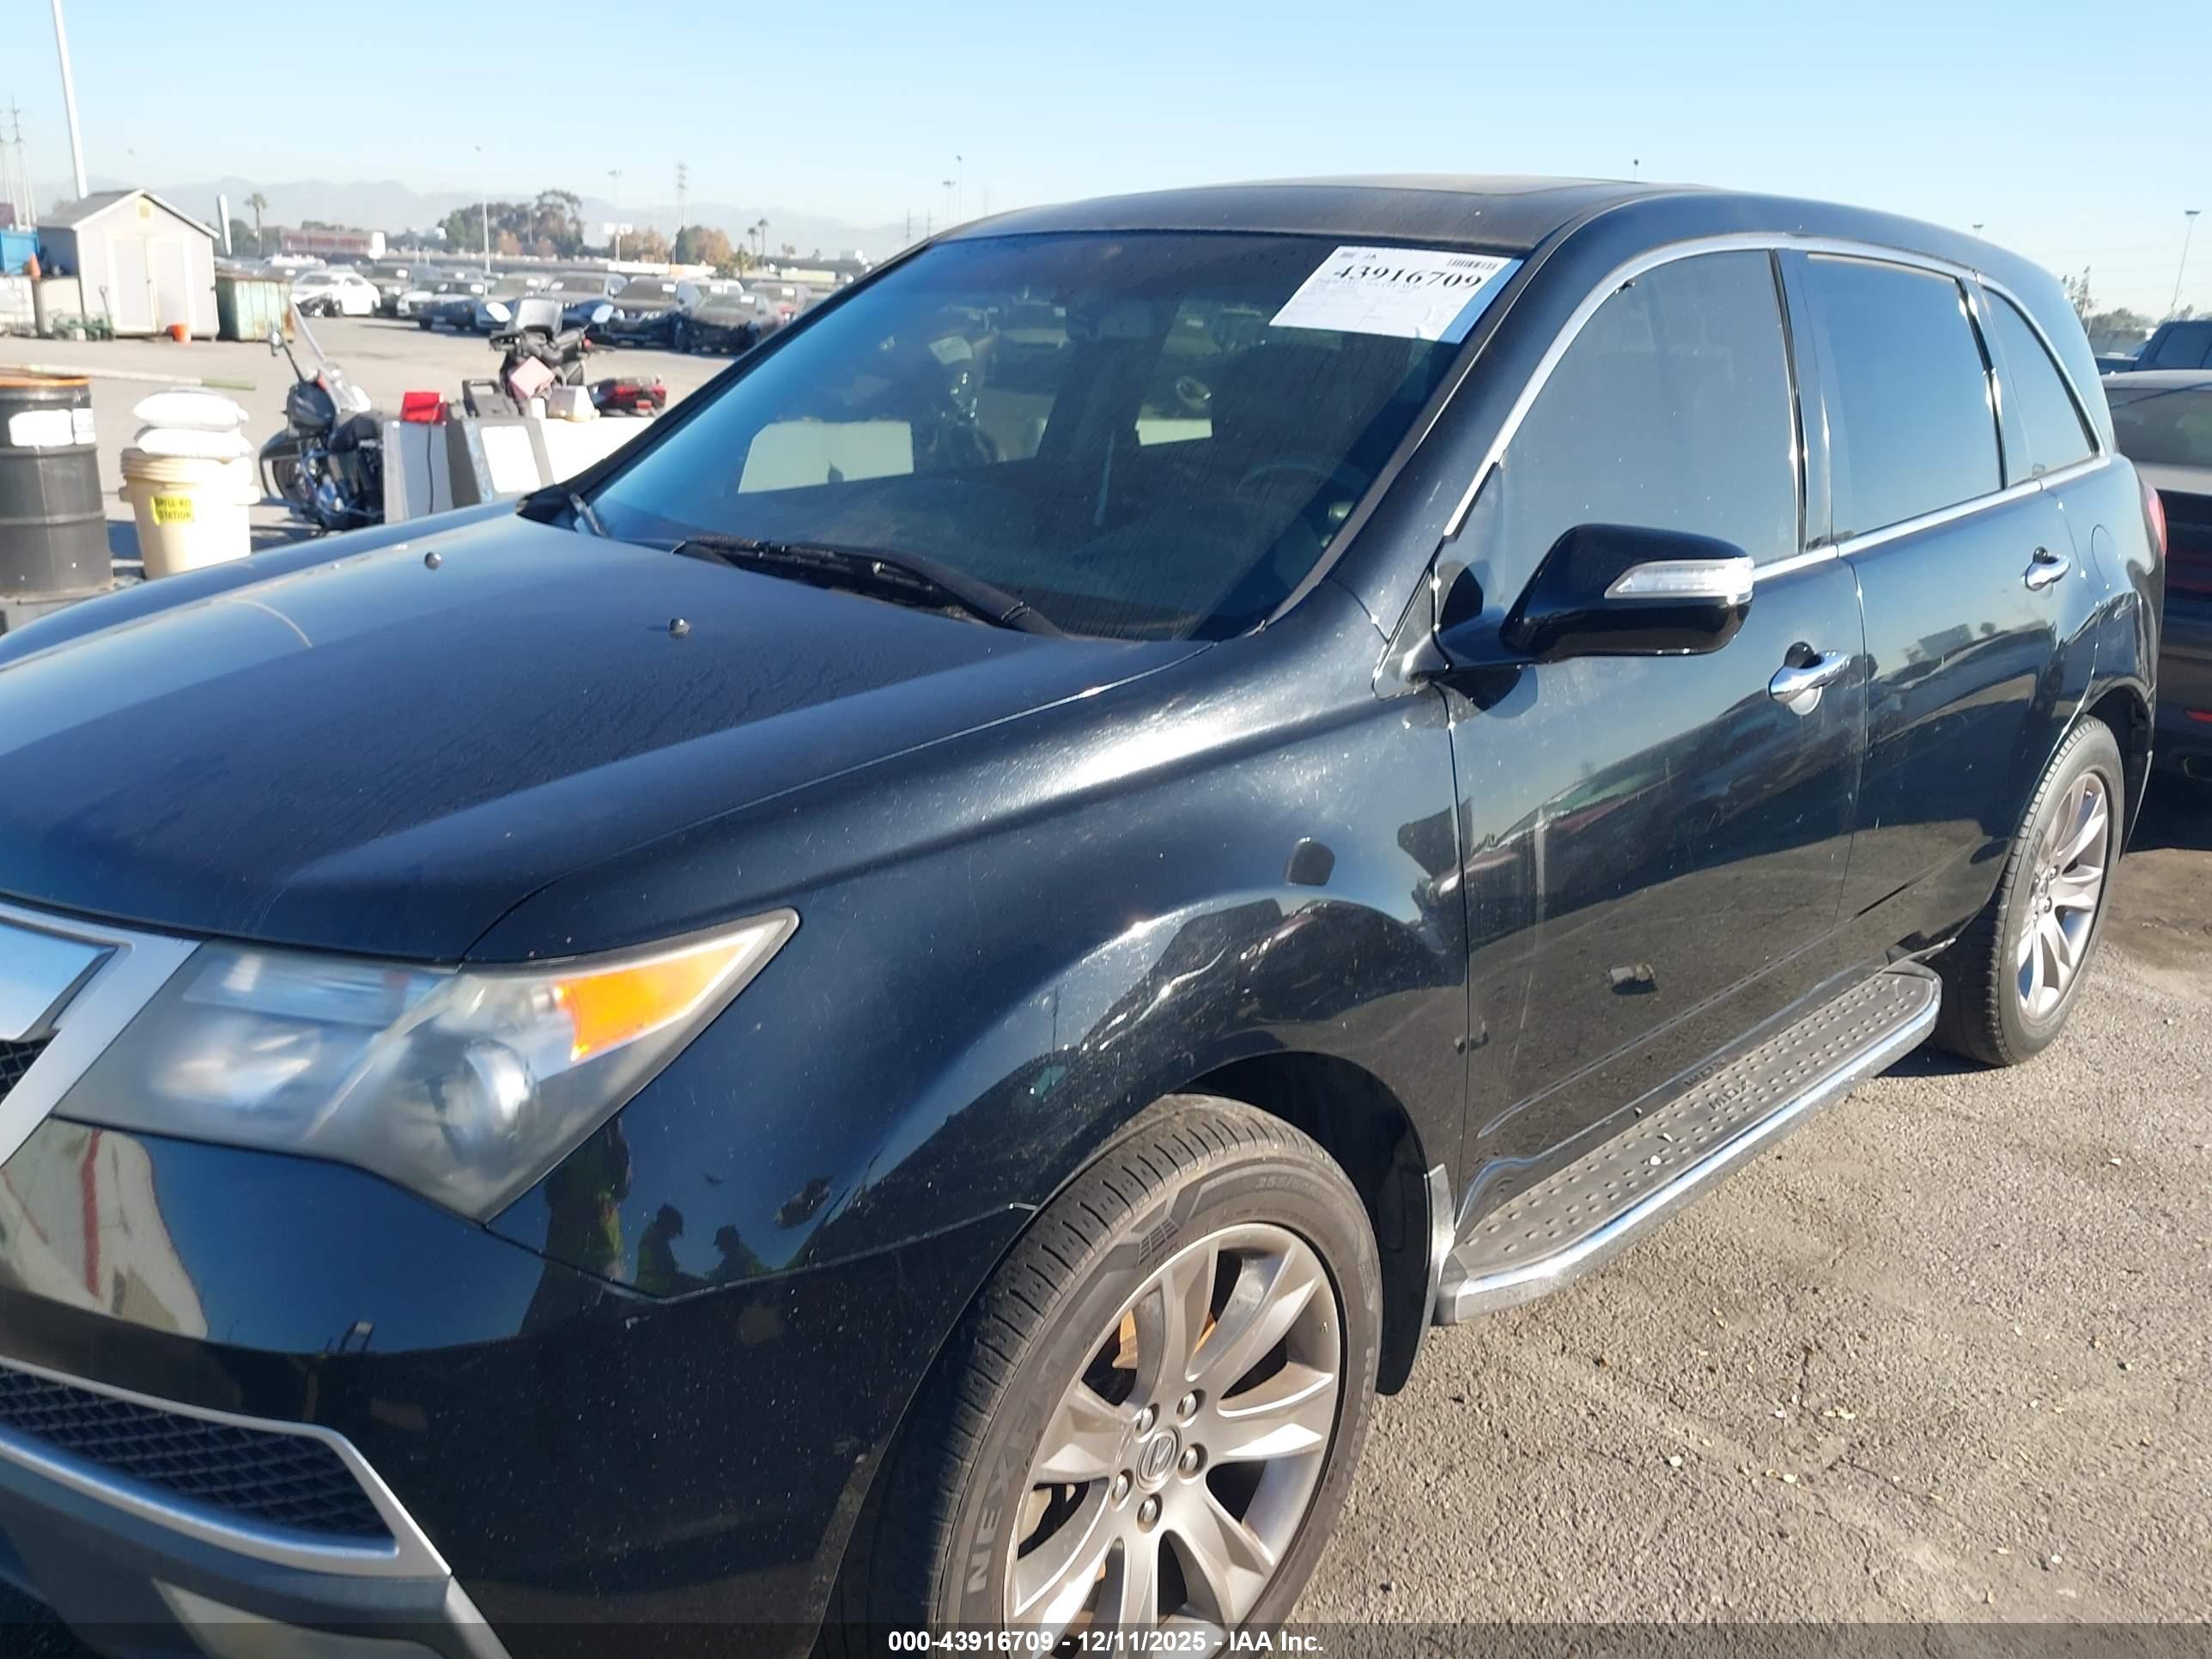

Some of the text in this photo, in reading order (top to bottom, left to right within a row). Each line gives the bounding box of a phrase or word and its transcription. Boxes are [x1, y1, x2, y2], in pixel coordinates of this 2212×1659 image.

[1334, 264, 1483, 289] 43916709
[1709, 1078, 1757, 1111] MDX
[966, 1354, 1066, 1595] NEXEN
